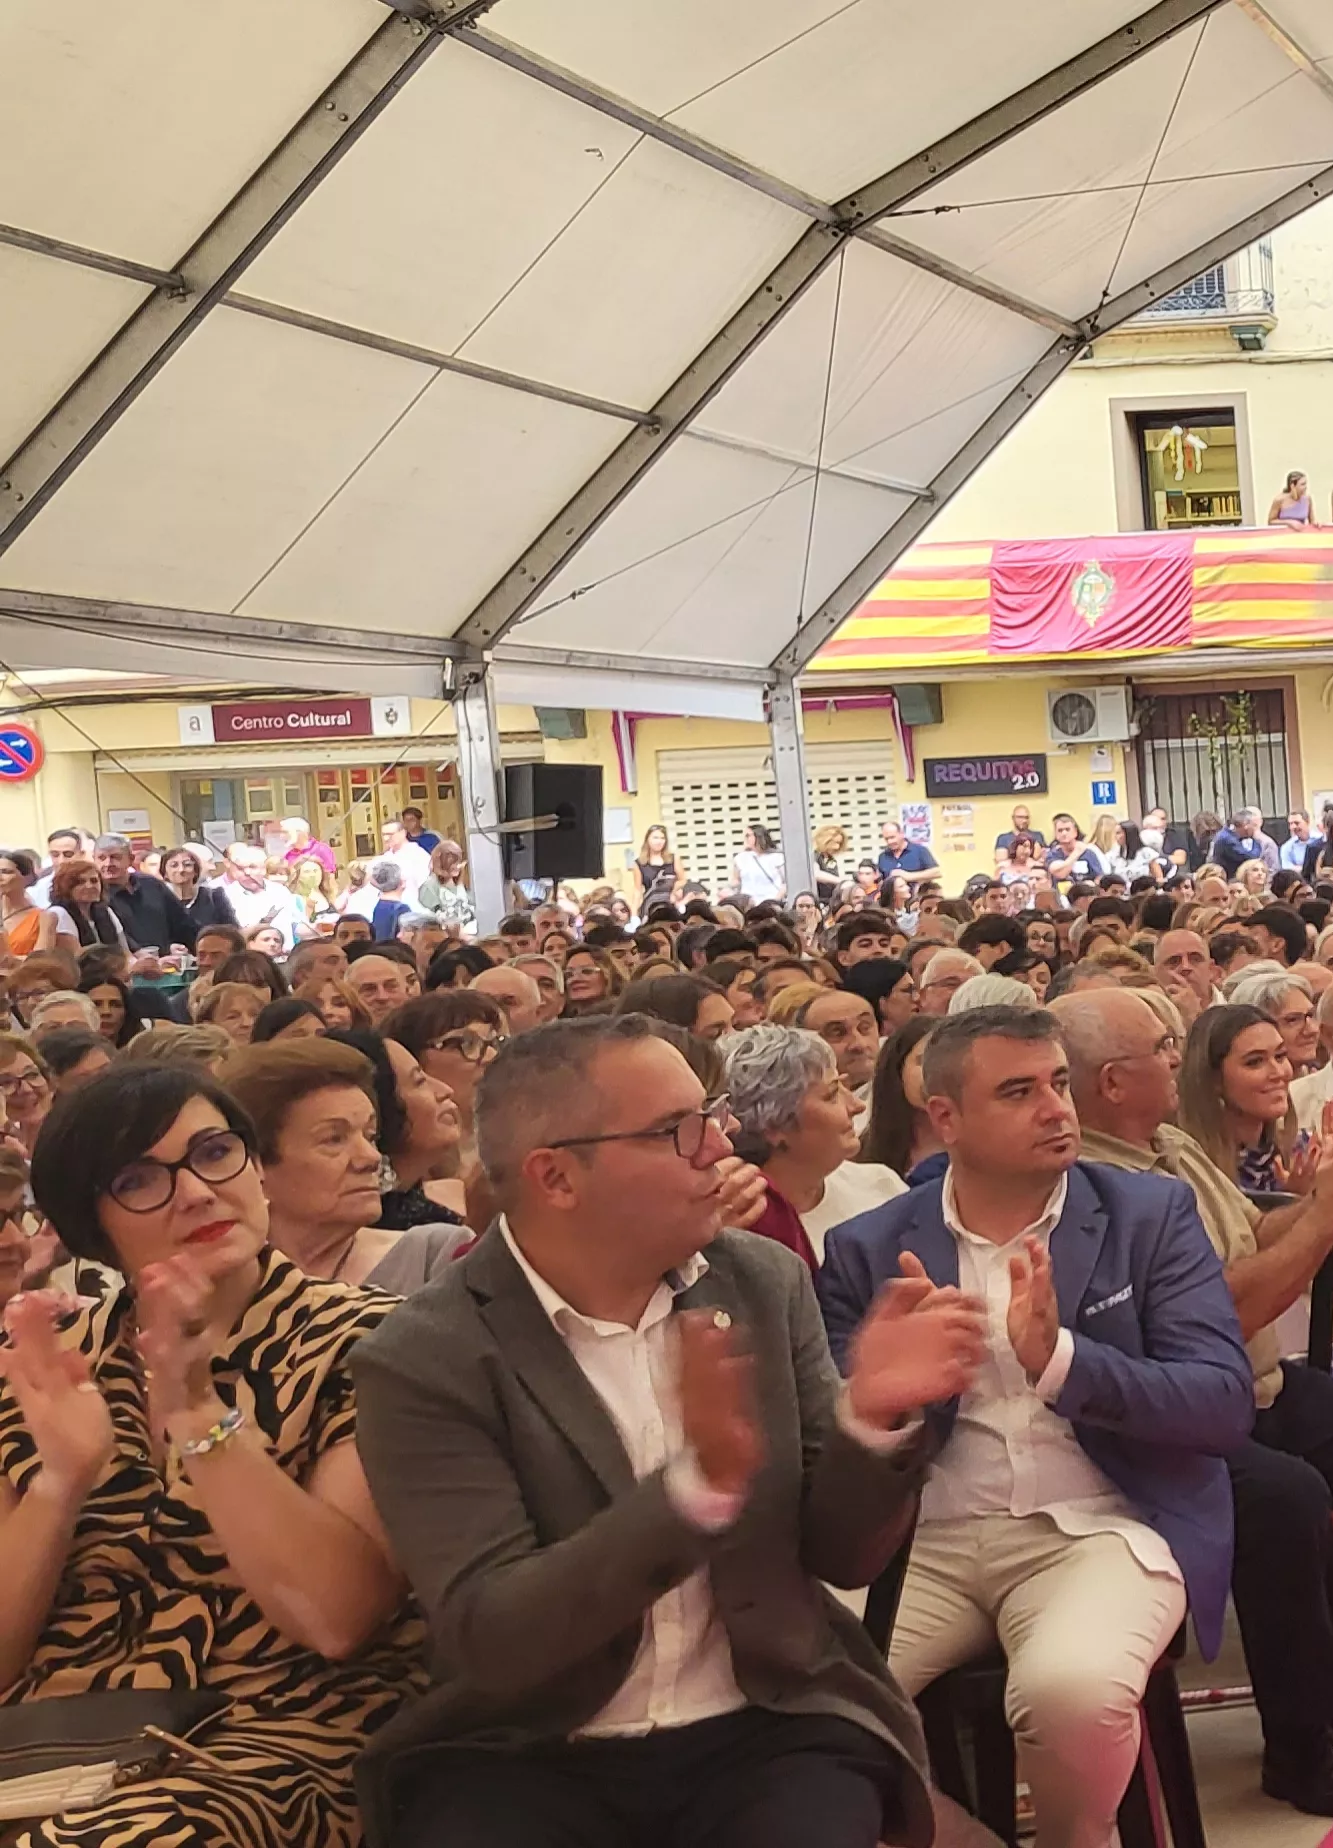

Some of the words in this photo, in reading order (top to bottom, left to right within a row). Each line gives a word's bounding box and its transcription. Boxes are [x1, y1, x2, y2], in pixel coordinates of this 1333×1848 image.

[231, 715, 284, 731] Centro
[286, 710, 351, 728] Cultural
[934, 760, 1035, 783] REQUITOS
[1011, 771, 1040, 790] 2.0
